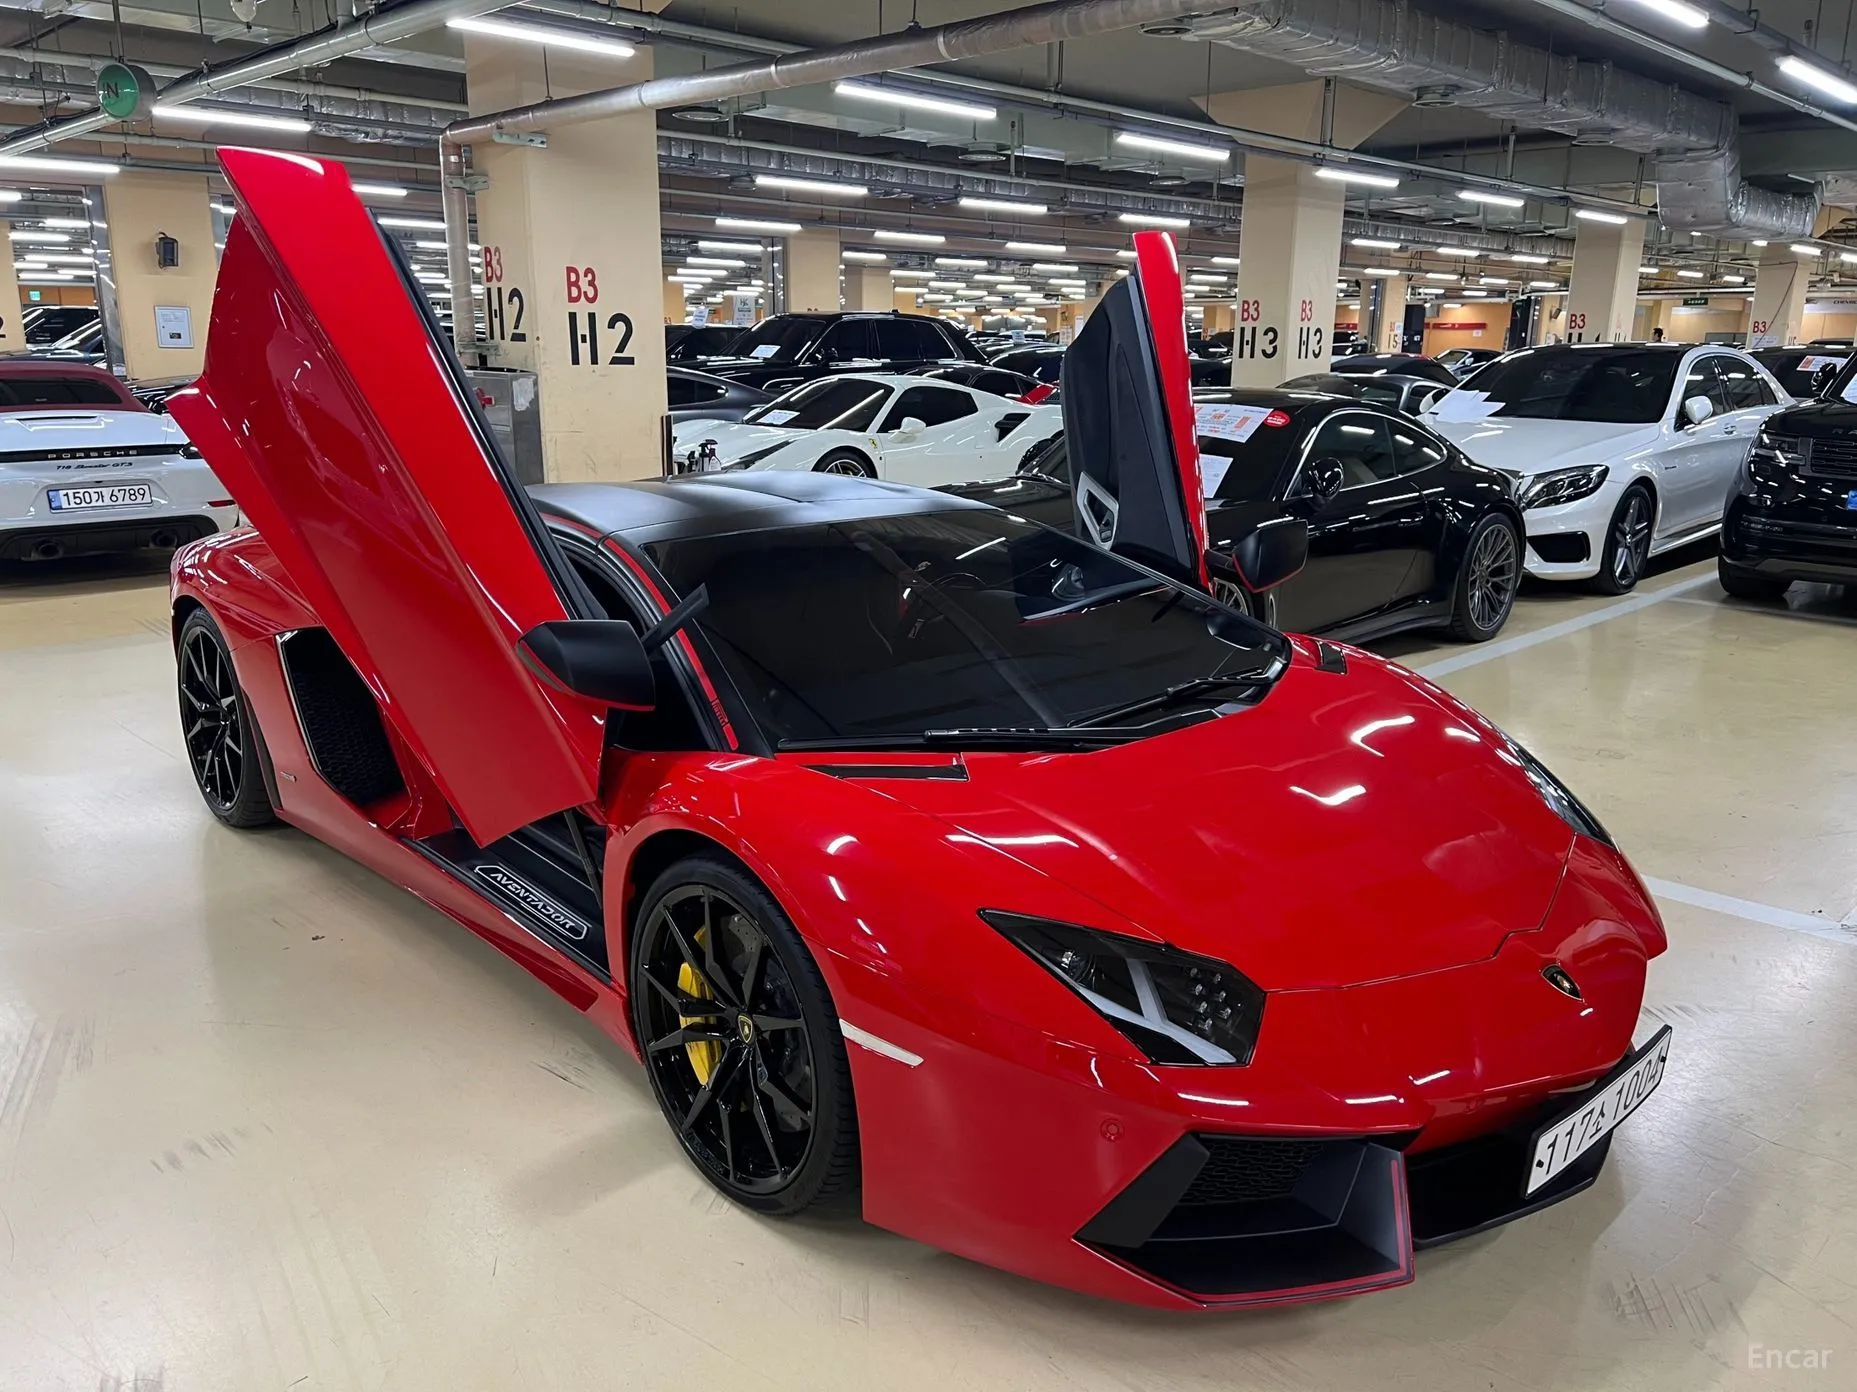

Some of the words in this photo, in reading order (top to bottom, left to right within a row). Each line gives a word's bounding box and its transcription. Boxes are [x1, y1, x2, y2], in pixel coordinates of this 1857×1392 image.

[484, 246, 503, 283] B3
[566, 266, 599, 304] B3
[1241, 299, 1260, 322] B3
[1300, 300, 1313, 322] B3
[1569, 313, 1586, 330] B3
[1752, 321, 1767, 334] B3
[48, 449, 138, 459] PORSCHE
[63, 490, 105, 507] 150가
[110, 487, 147, 503] 6789
[490, 872, 576, 929] AVENTADOR
[1613, 1046, 1664, 1121] 1004
